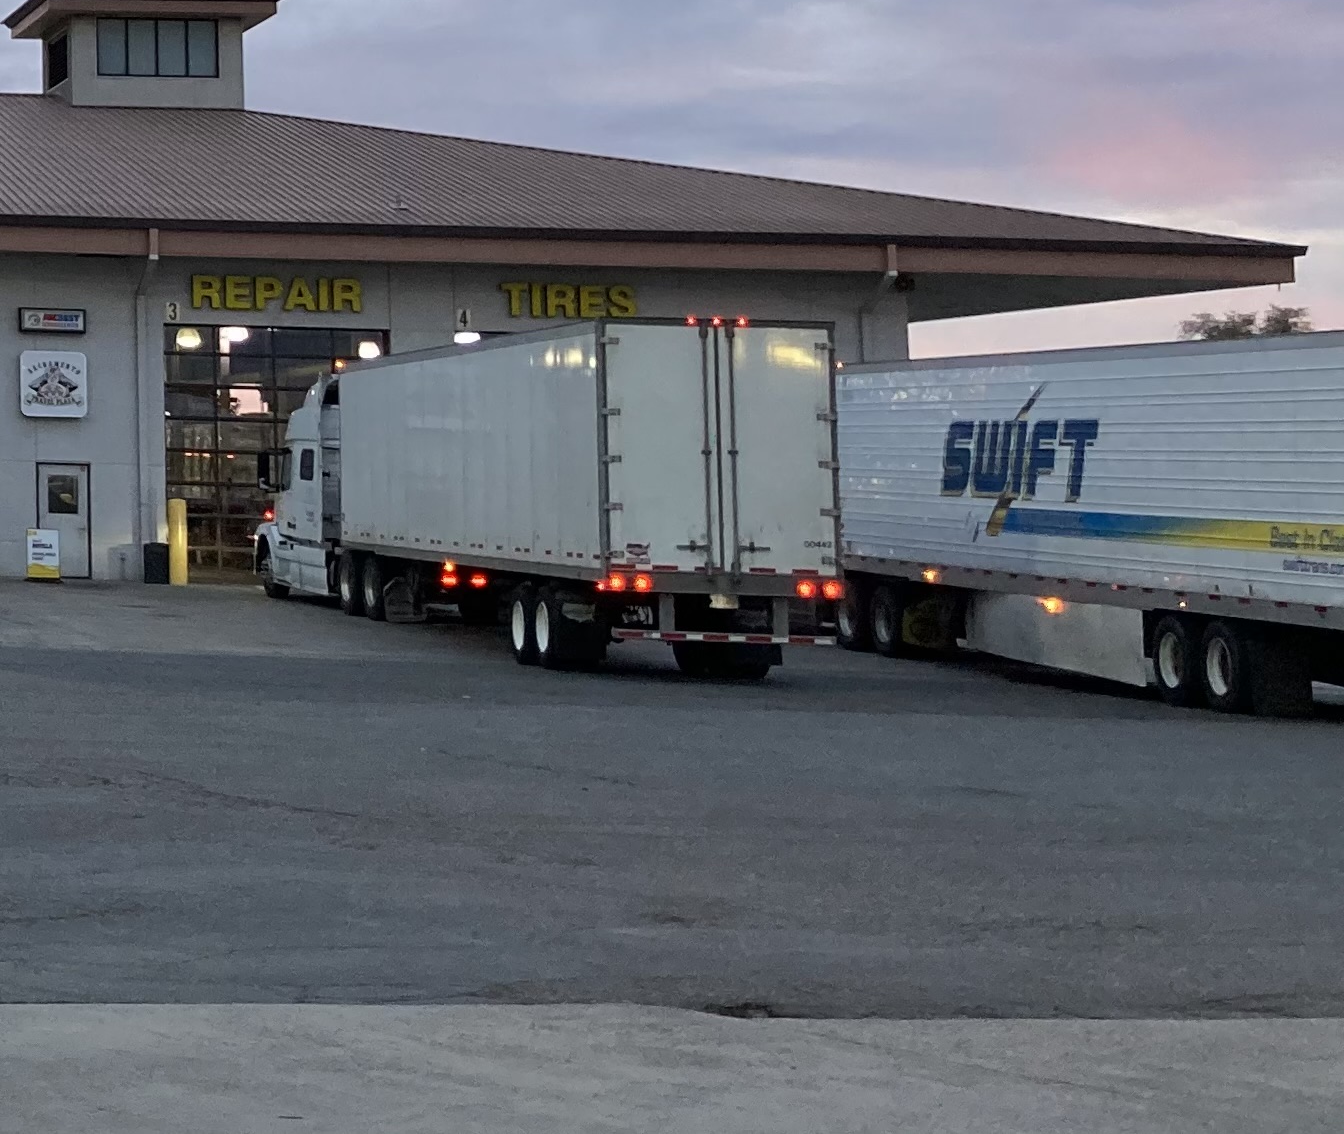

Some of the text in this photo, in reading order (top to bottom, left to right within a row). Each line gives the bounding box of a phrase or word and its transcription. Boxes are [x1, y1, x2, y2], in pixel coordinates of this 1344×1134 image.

[168, 302, 177, 321] 3
[191, 274, 362, 313] REPAIR
[499, 281, 637, 318] TIRES
[459, 310, 468, 327] 4
[940, 418, 1100, 503] SWIFT
